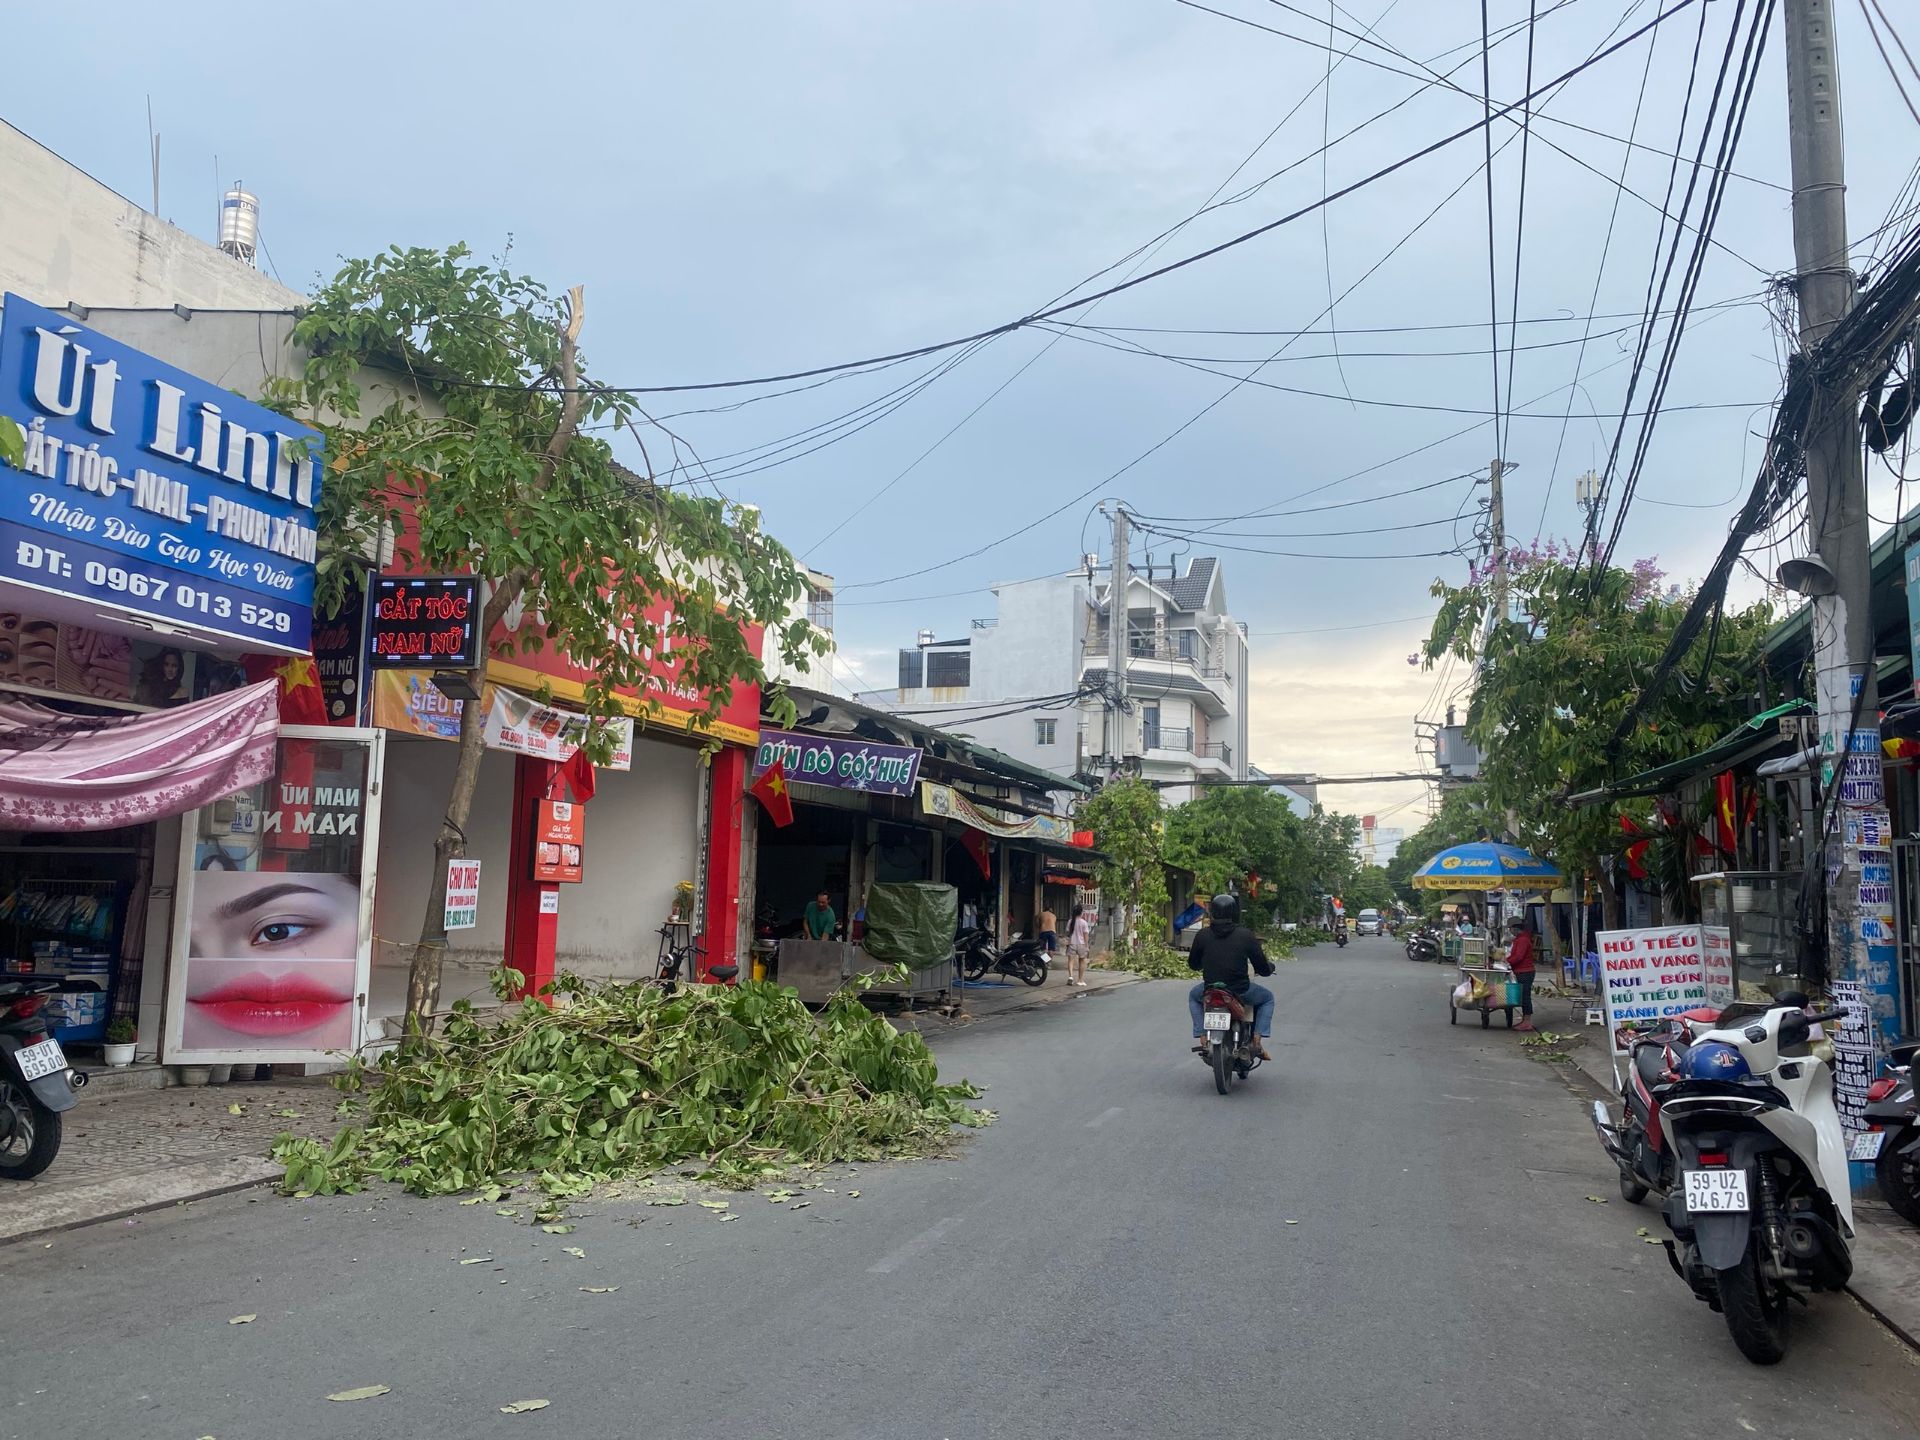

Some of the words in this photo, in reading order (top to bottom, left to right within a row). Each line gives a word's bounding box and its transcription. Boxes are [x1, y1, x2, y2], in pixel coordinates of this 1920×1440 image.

[33, 325, 122, 436] Út
[149, 379, 314, 509] Linh
[28, 493, 97, 533] Nhận
[102, 516, 151, 550] Đào
[158, 532, 201, 564] Tạo
[208, 548, 249, 577] Học
[252, 561, 296, 590] Viên
[268, 516, 317, 565] XĂM
[16, 541, 72, 578] ĐT:
[85, 560, 170, 602] 0967
[176, 584, 232, 617] 013
[240, 604, 292, 633] 529
[379, 587, 421, 621] CẮT
[426, 591, 468, 621] TÓC
[377, 632, 426, 656] NAM
[429, 622, 465, 655] NỮ
[317, 658, 336, 676] AM
[758, 740, 801, 771] BÚN
[802, 744, 834, 775] BÒ
[838, 748, 876, 781] GỐC
[877, 752, 918, 785] HUẾ
[1603, 938, 1635, 954] HỦ
[1643, 932, 1698, 951] TIẾU
[1606, 957, 1646, 971] NAM
[1651, 954, 1700, 969] VANG
[1609, 976, 1642, 988] NUI
[1660, 971, 1704, 984] BÚN
[1639, 987, 1680, 1002] TIẾU
[1614, 1005, 1659, 1020] BÁNH
[22, 1043, 53, 1063] 59-U1
[1692, 1172, 1738, 1190] 59-U2
[1689, 1191, 1746, 1211] 346.79
